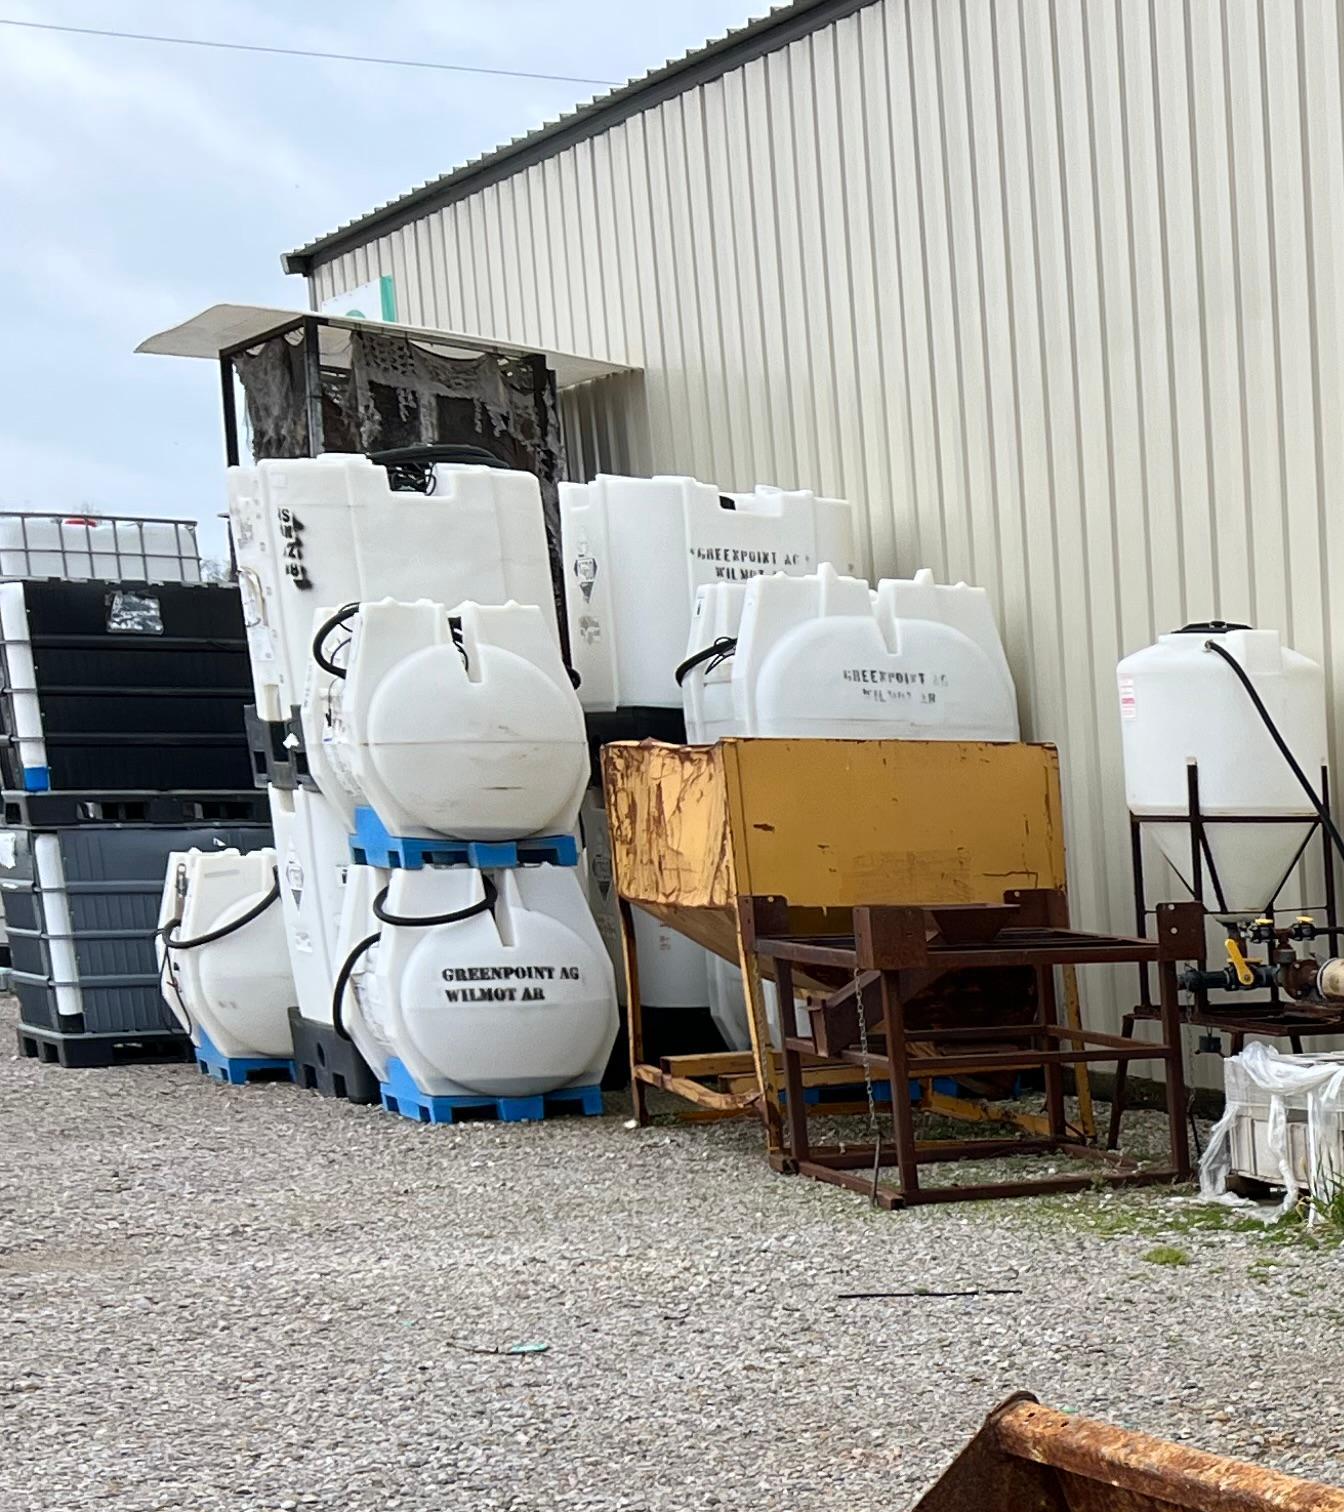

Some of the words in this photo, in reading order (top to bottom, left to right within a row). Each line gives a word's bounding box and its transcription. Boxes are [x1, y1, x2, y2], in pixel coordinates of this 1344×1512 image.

[441, 965, 556, 982] GREENPOINT
[559, 966, 580, 981] AG
[445, 986, 518, 1003] WILMOT
[521, 986, 546, 1001] AR
